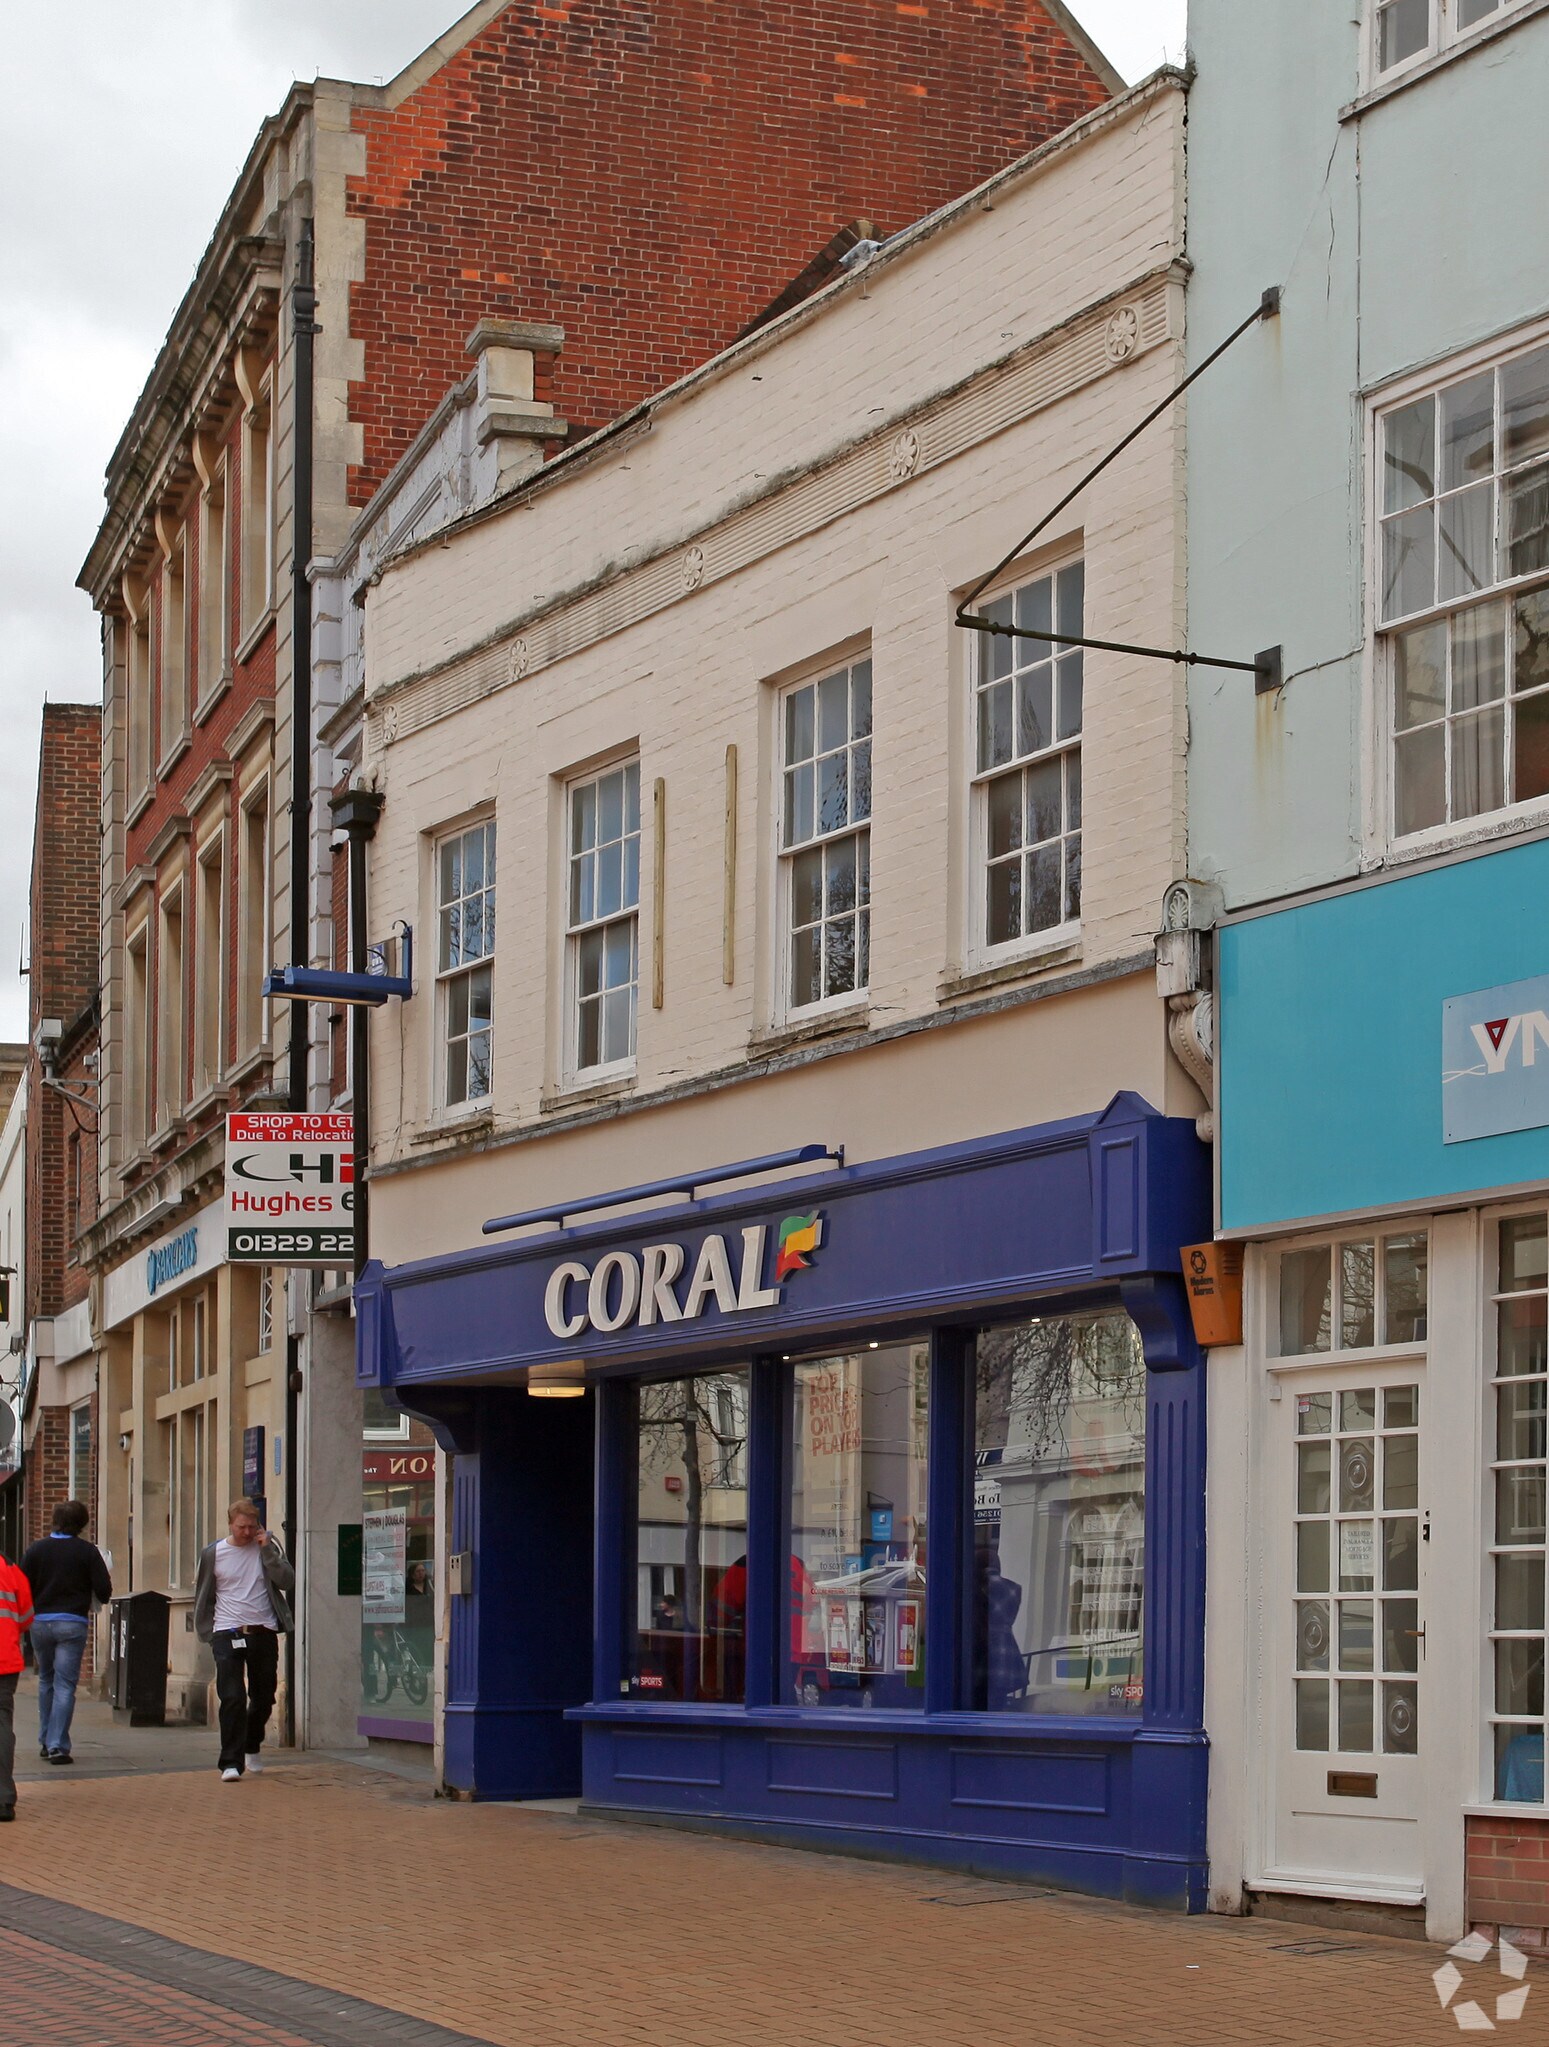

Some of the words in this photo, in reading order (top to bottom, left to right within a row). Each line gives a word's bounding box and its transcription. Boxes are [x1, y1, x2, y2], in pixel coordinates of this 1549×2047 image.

[248, 1116, 294, 1128] SHOP
[300, 1116, 322, 1128] TO
[329, 1116, 354, 1128] LET
[236, 1130, 264, 1140] Due
[270, 1129, 287, 1140] To
[293, 1130, 354, 1141] Relocati
[231, 1191, 333, 1217] Hughes
[235, 1234, 314, 1252] 01329
[544, 1224, 780, 1339] CORAL
[810, 1415, 834, 1437] ON
[640, 1676, 662, 1686] SPORTS
[1110, 1685, 1123, 1698] sky
